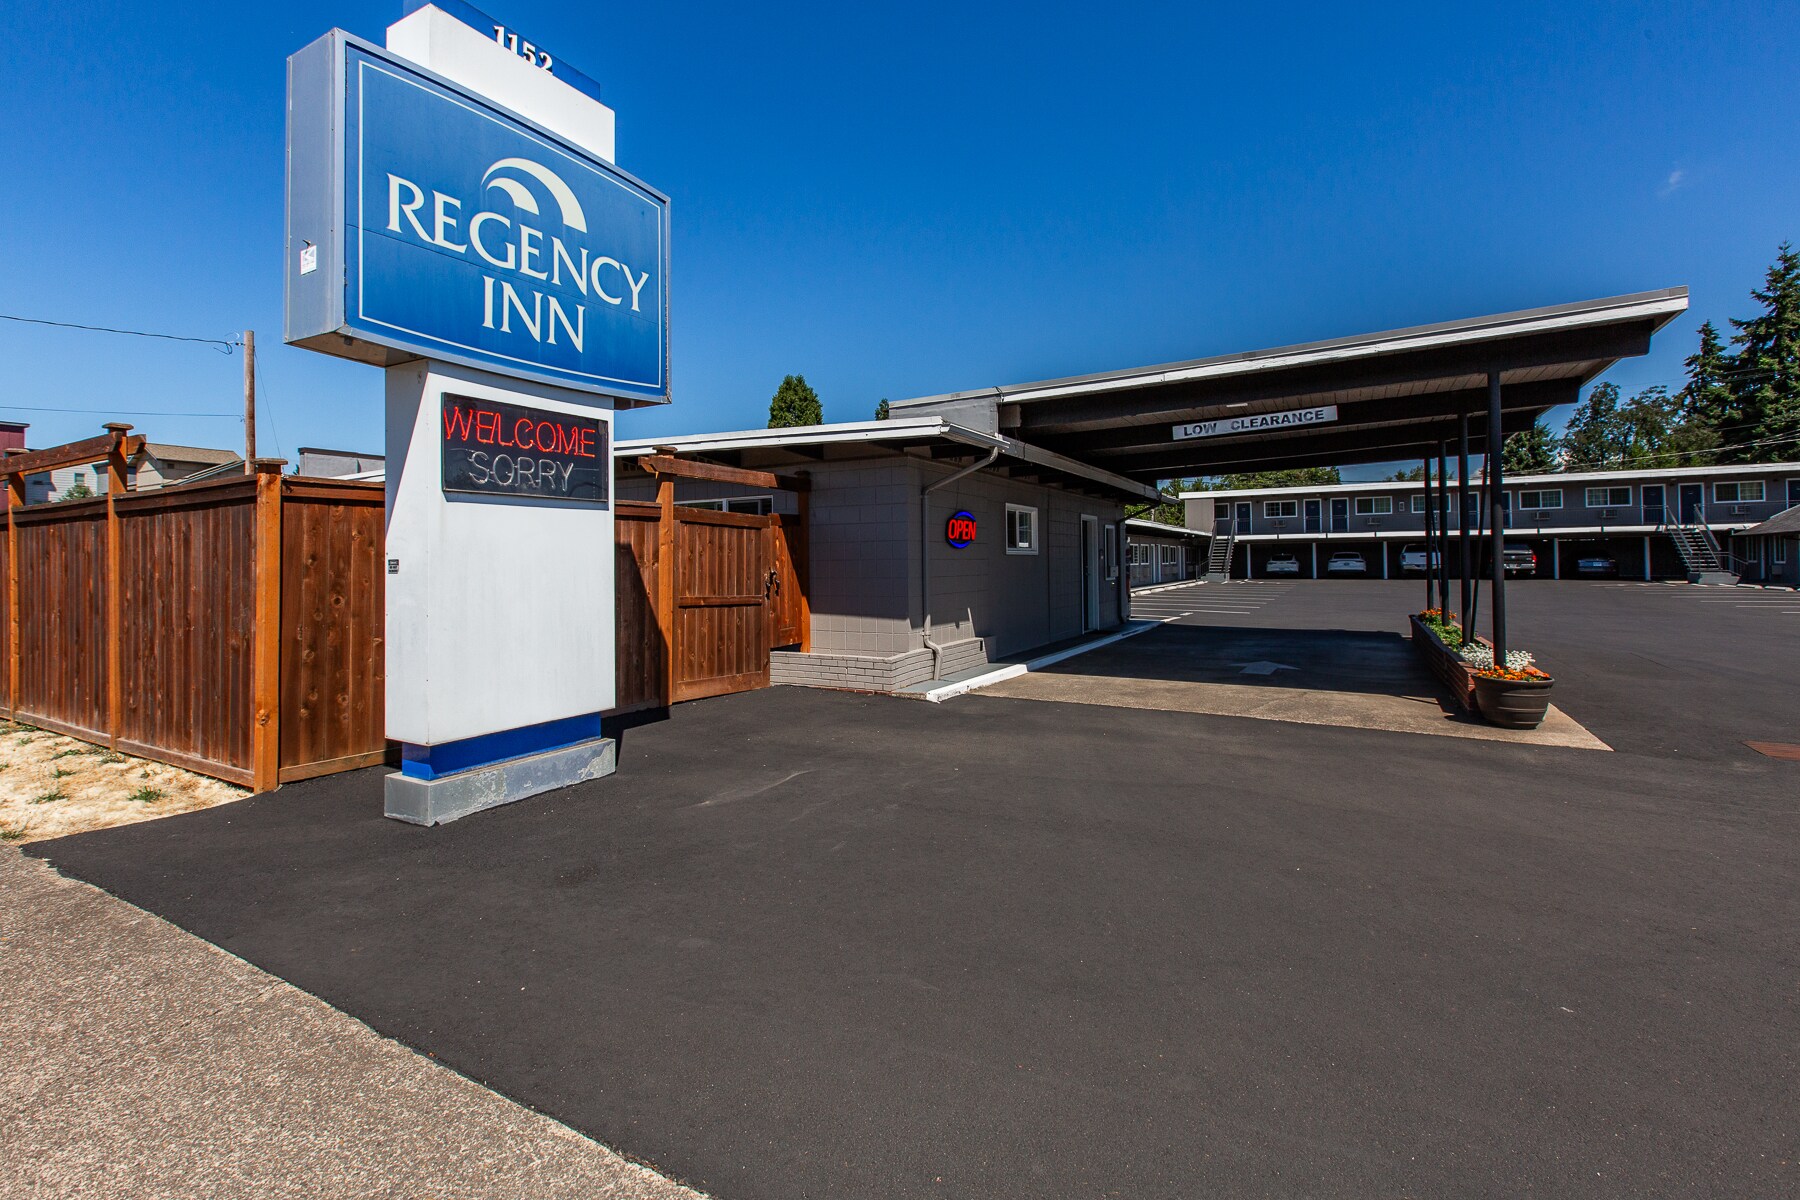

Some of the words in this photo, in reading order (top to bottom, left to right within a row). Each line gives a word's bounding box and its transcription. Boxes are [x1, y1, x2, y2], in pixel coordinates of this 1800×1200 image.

[493, 25, 553, 75] 1152
[386, 173, 650, 312] REGENCY
[482, 275, 586, 353] INN
[443, 406, 596, 457] WELCOME
[1183, 422, 1217, 437] LOW
[1230, 409, 1325, 431] CLEARANCE
[467, 451, 574, 492] SORRY
[947, 519, 977, 541] OPEN
